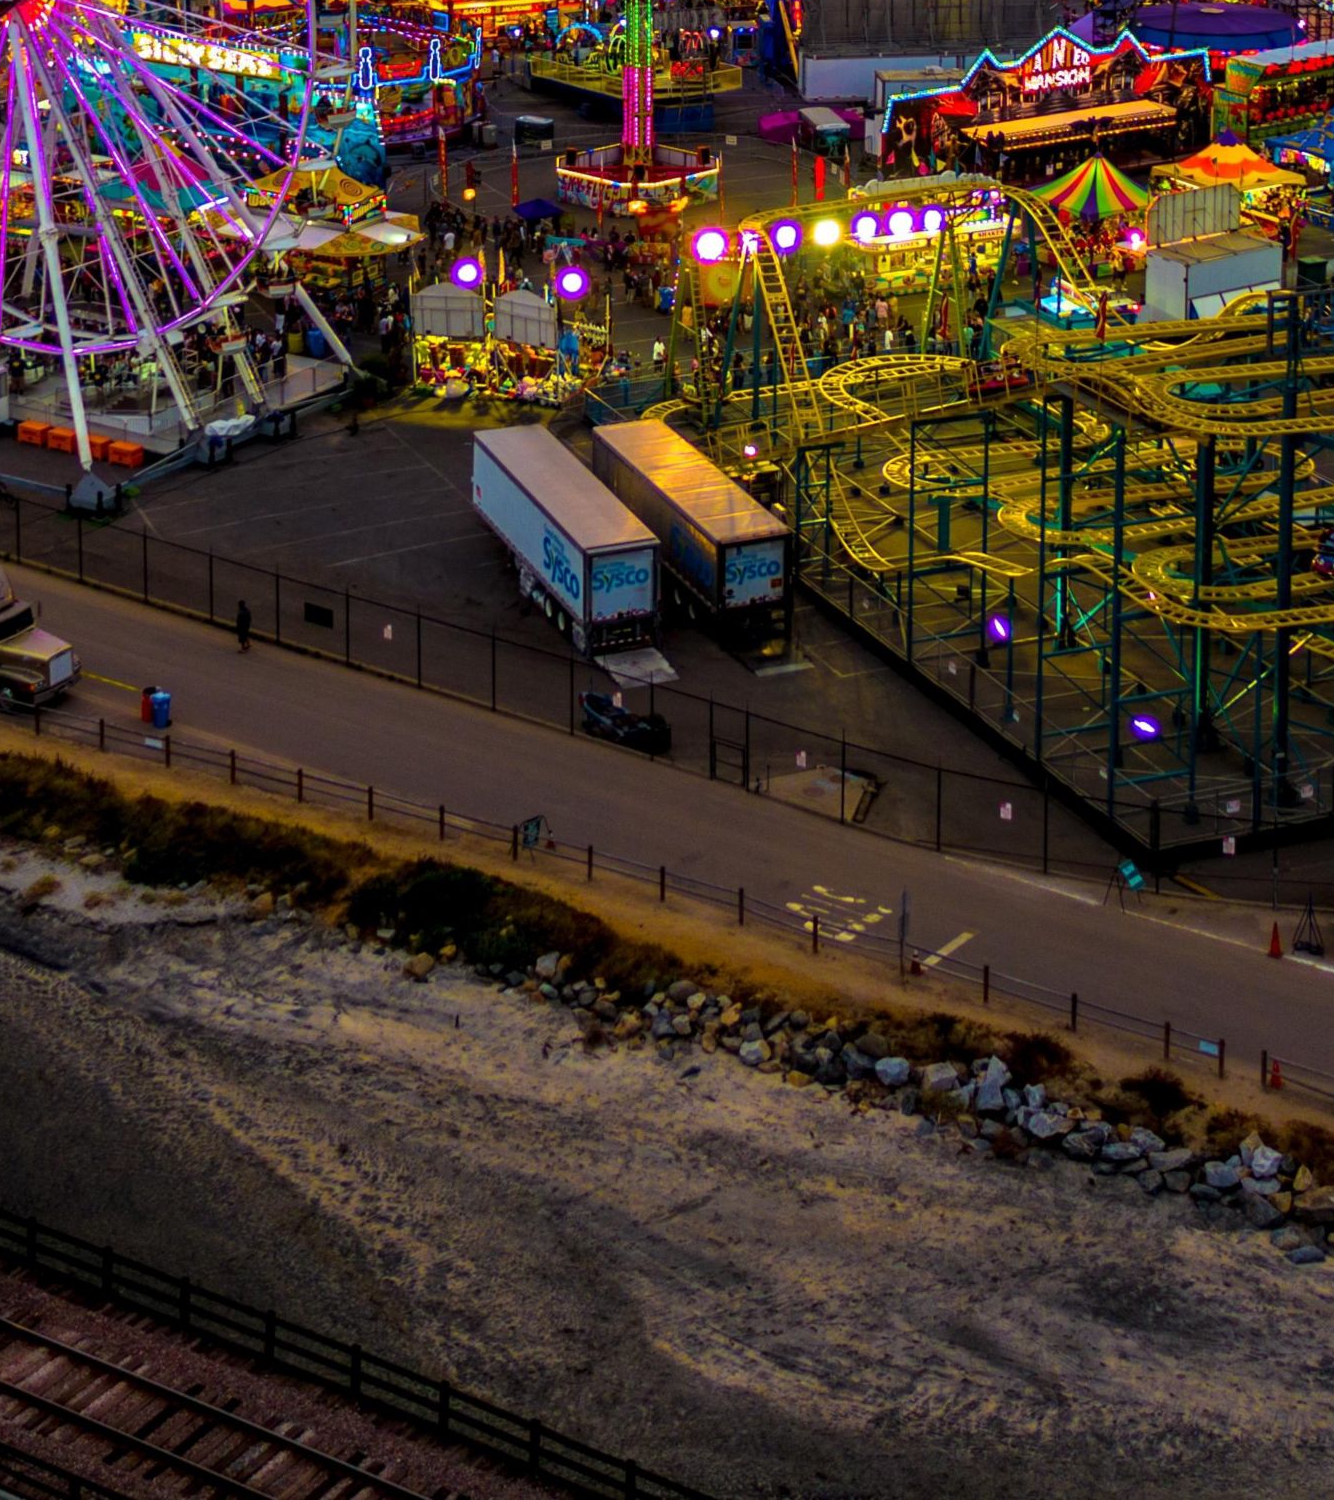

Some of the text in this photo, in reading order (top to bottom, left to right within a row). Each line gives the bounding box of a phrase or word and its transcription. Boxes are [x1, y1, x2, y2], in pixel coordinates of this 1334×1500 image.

[1024, 39, 1091, 74] HAUNTED
[1024, 66, 1091, 92] MANSION
[543, 536, 580, 600] Sysco
[592, 567, 650, 593] Sysco
[726, 560, 781, 586] Sysco
